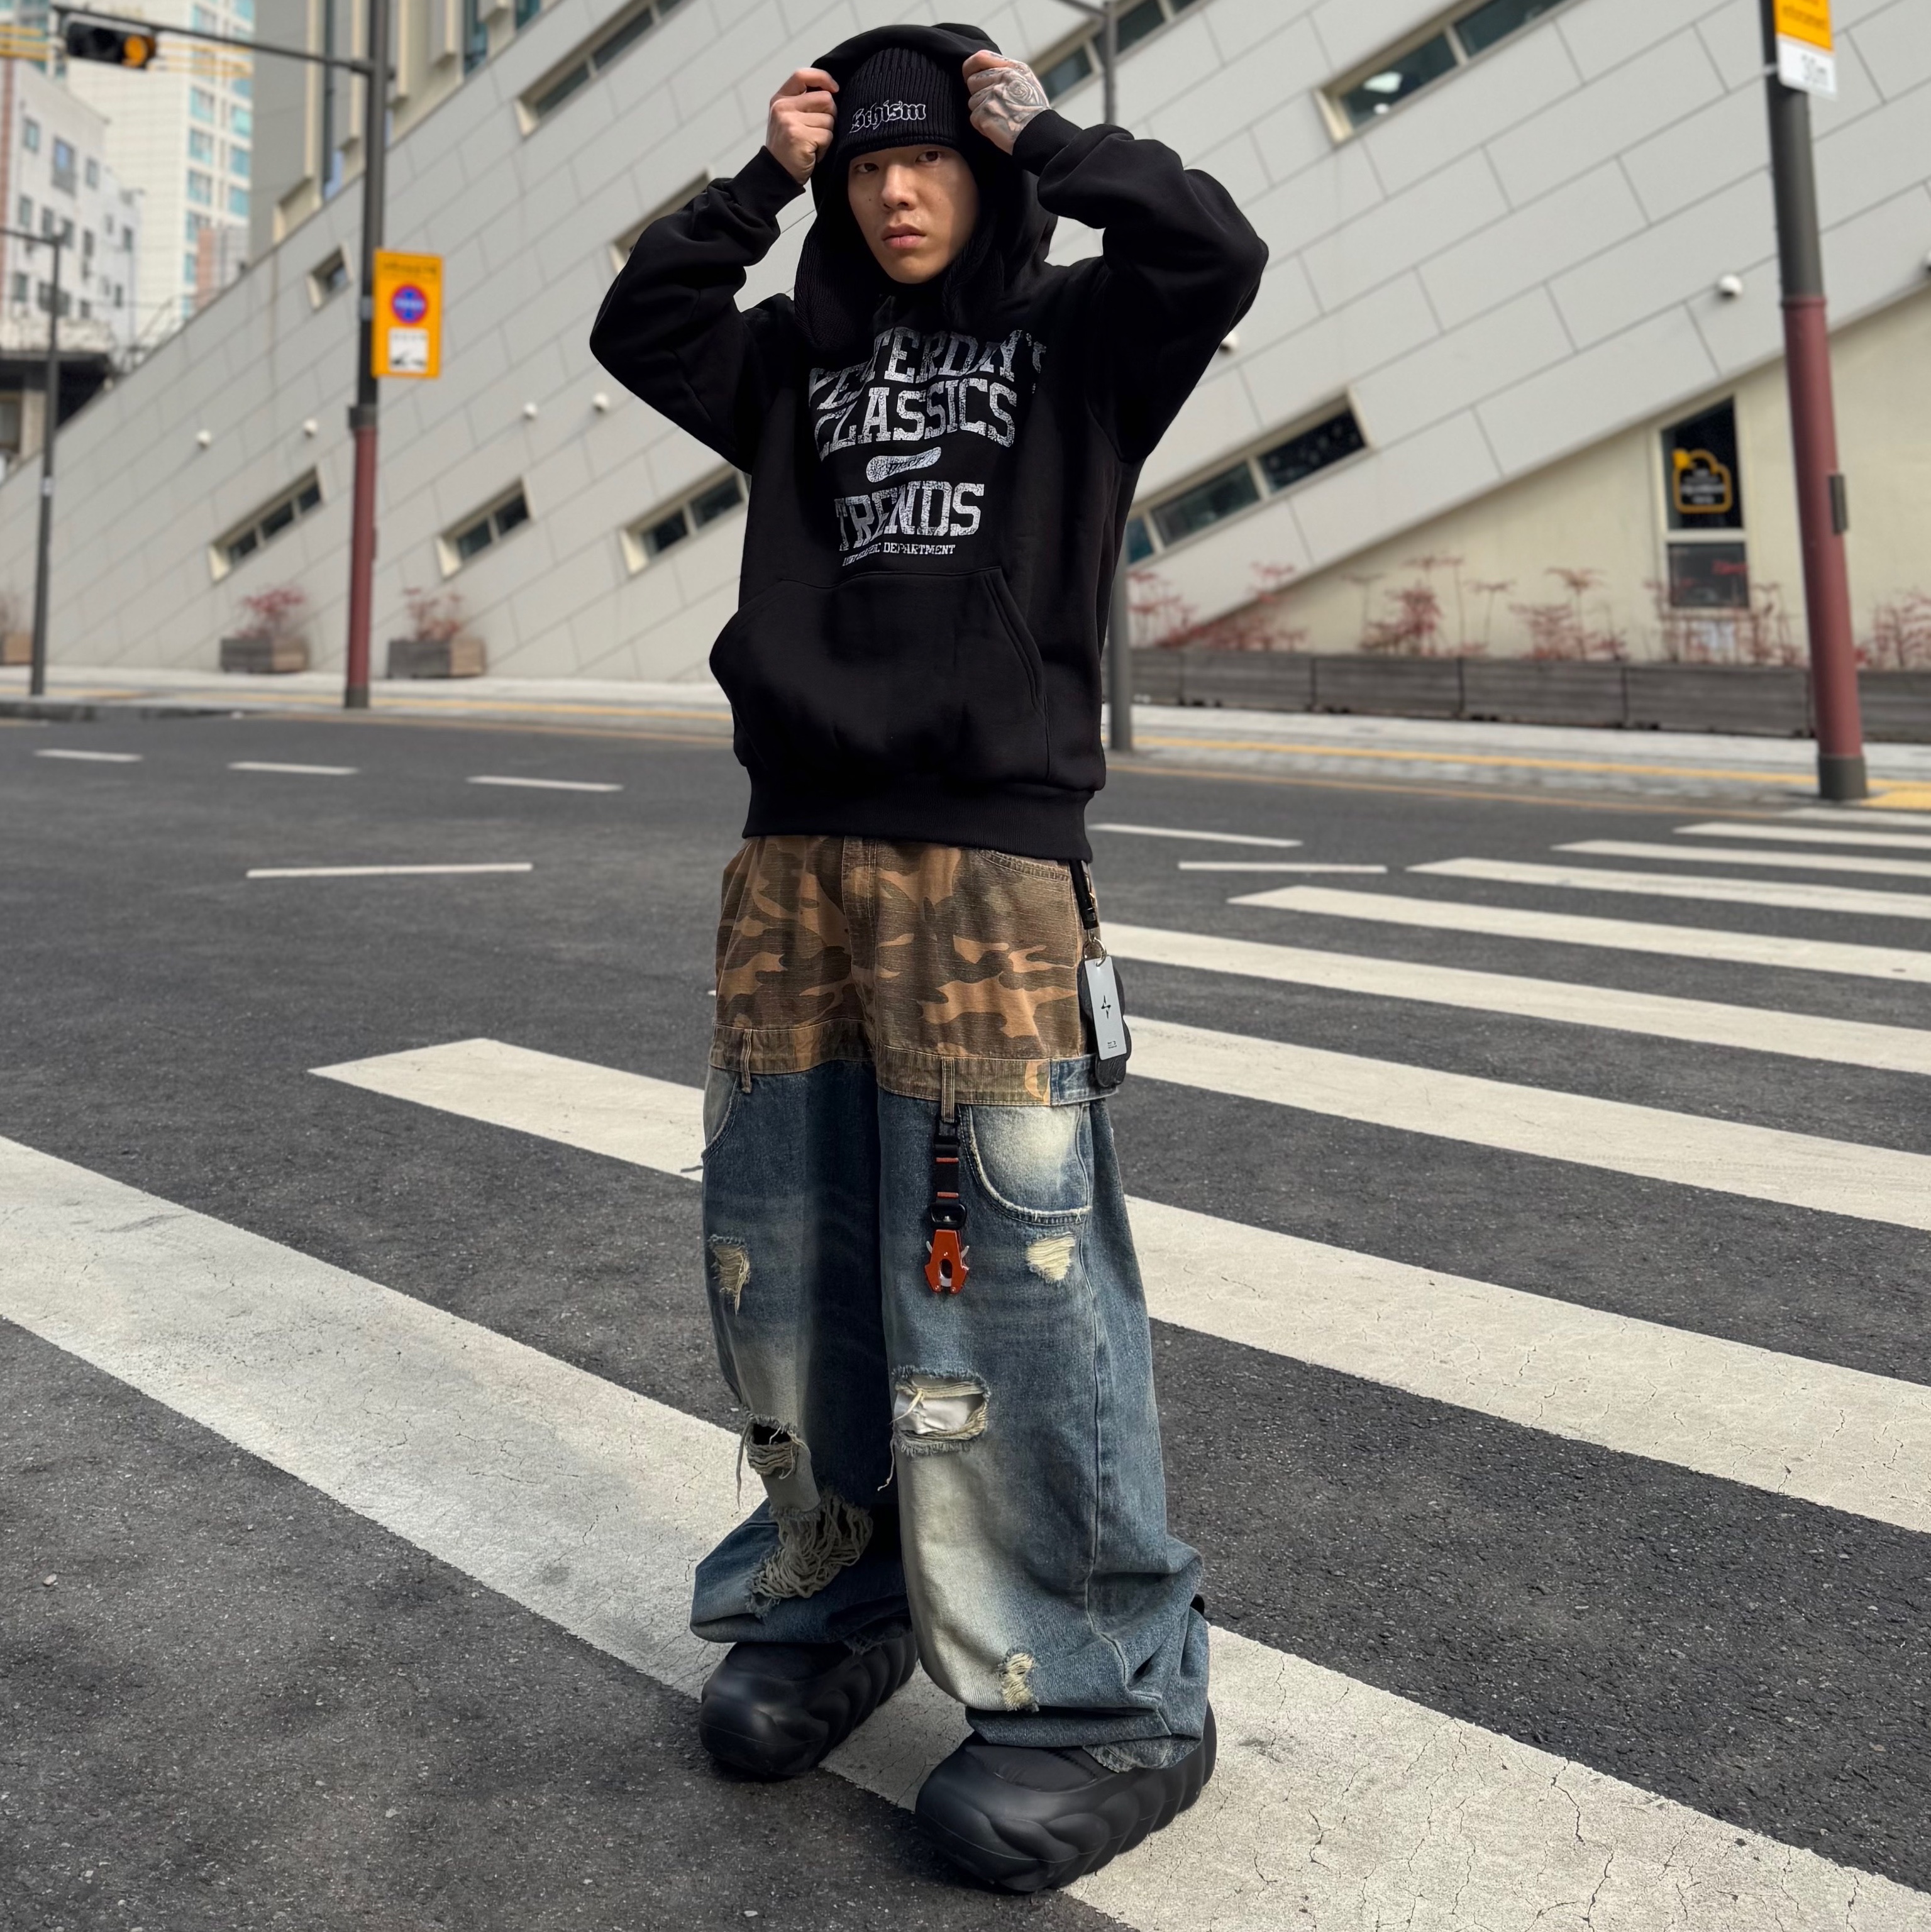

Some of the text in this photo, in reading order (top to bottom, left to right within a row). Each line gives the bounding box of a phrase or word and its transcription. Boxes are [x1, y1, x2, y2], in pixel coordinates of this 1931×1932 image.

[814, 377, 1017, 462] CLASSICS
[834, 480, 985, 551] TRENDS
[883, 541, 956, 555] DEPARTMENT
